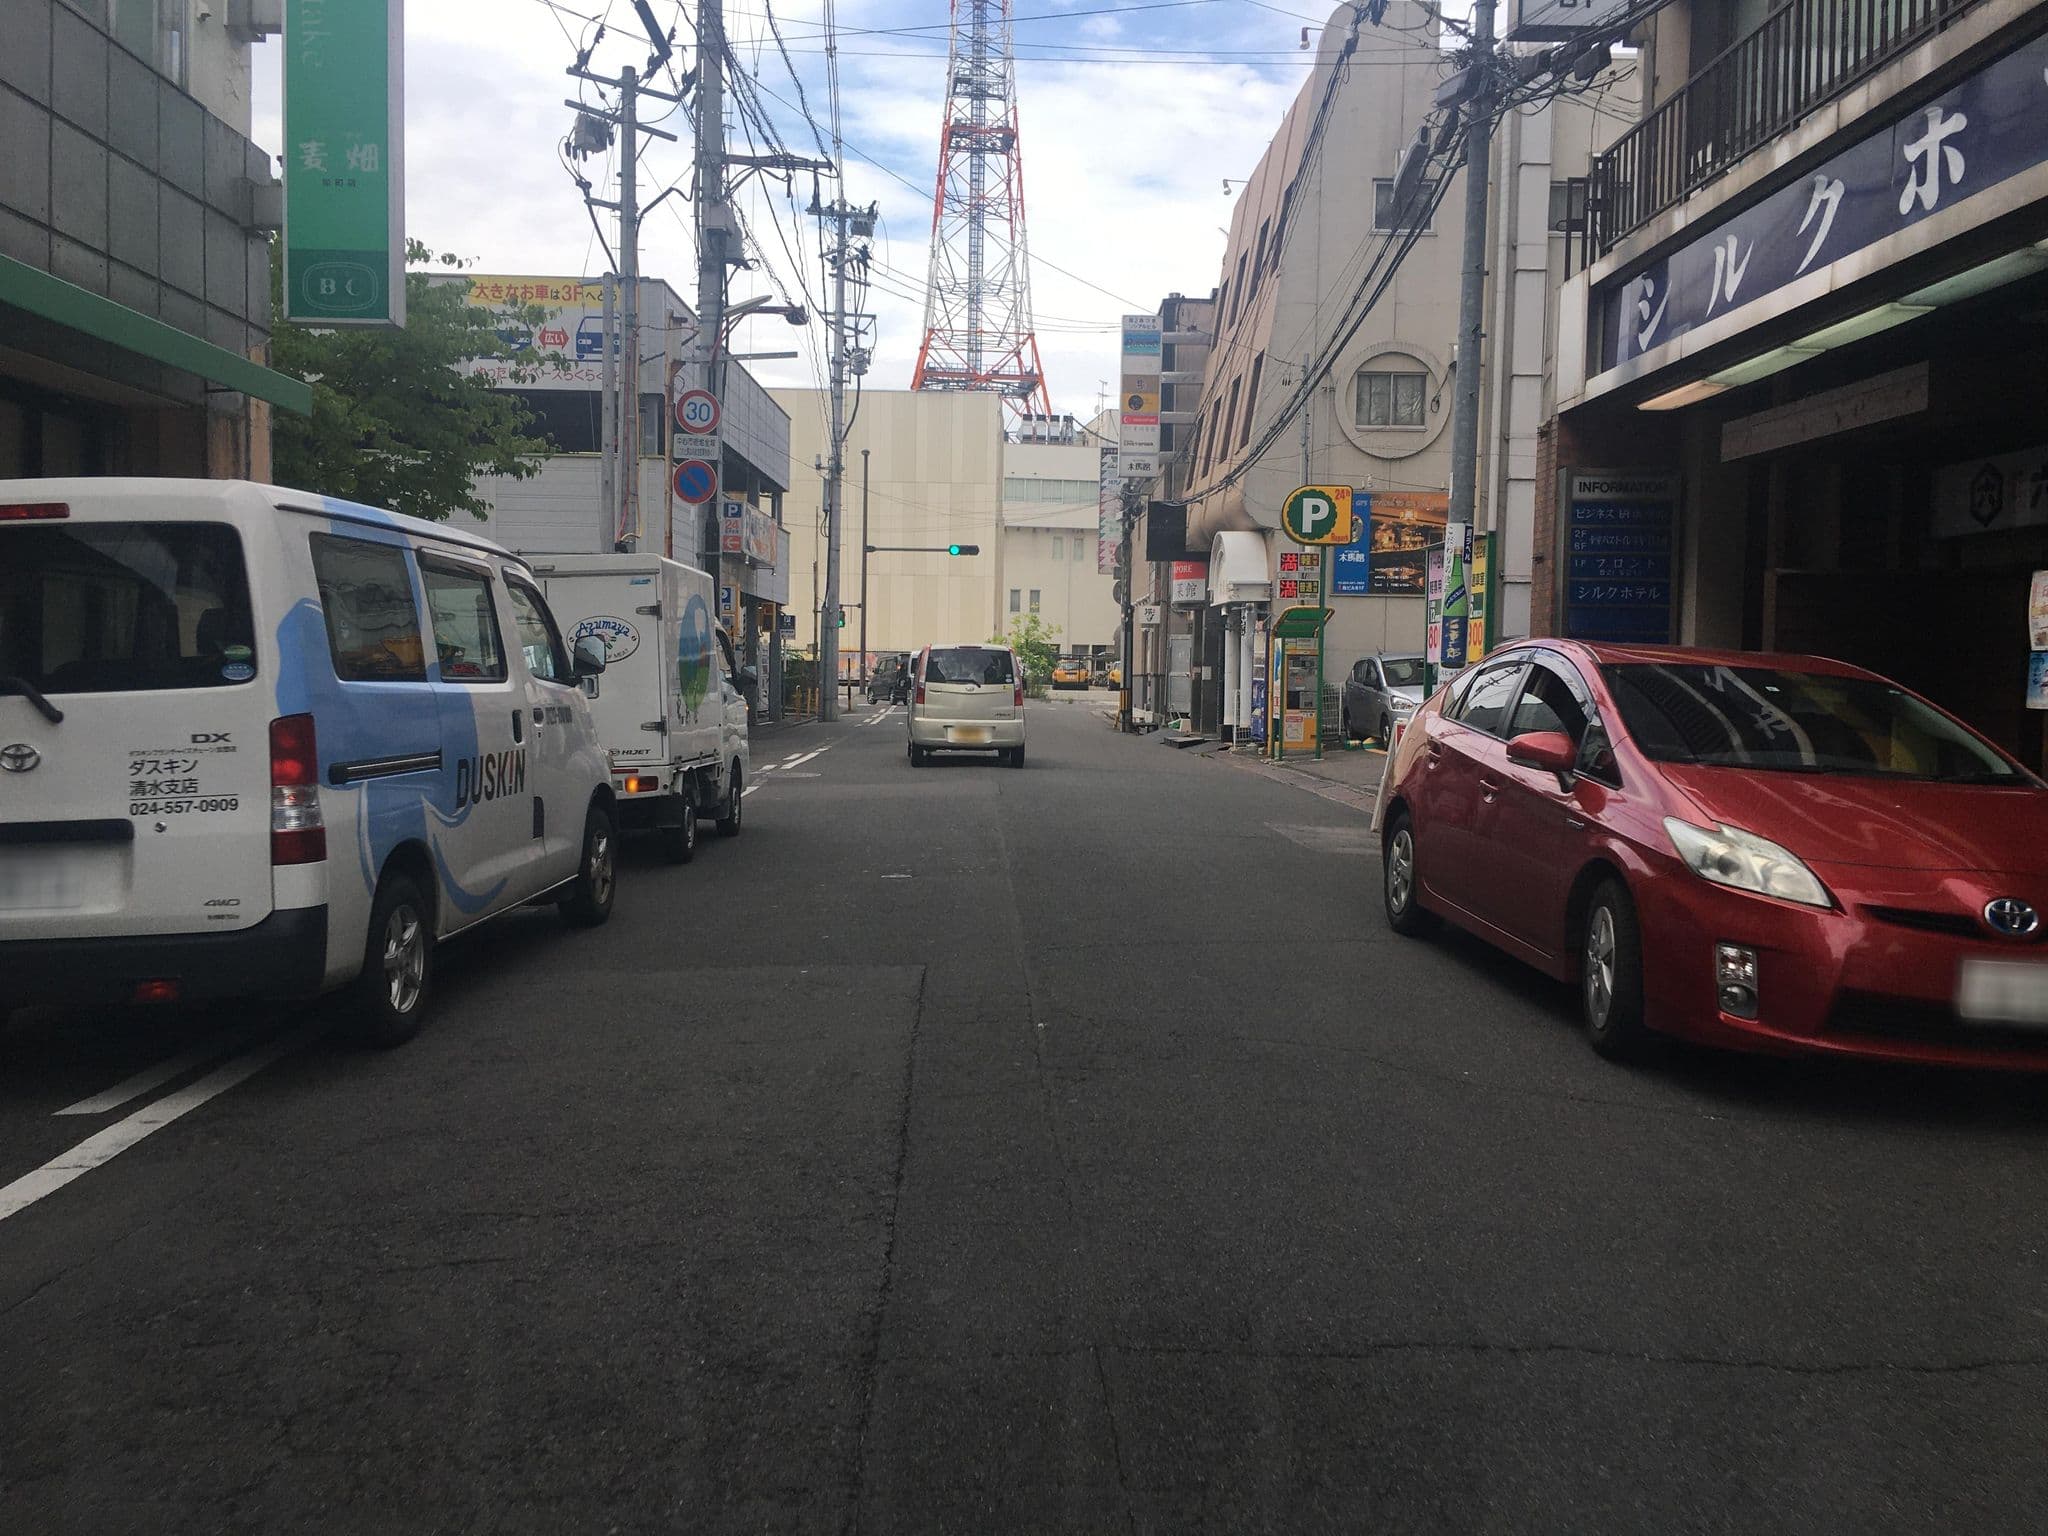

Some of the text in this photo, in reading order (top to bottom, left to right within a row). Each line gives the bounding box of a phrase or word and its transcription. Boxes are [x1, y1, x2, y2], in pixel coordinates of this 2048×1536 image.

[1636, 66, 2048, 352] シルクホ
[544, 333, 565, 344] 広い
[686, 402, 710, 421] 30
[727, 504, 739, 517] P
[1302, 498, 1330, 533] P
[725, 519, 739, 530] 24
[1574, 529, 1588, 539] 2F
[1576, 587, 1660, 600] シルクホテル
[575, 620, 631, 640] Azumaya
[191, 732, 232, 743] DX
[129, 759, 199, 777] ダスキン
[130, 778, 199, 797] 清水支店
[130, 798, 239, 817] 024-557-0909
